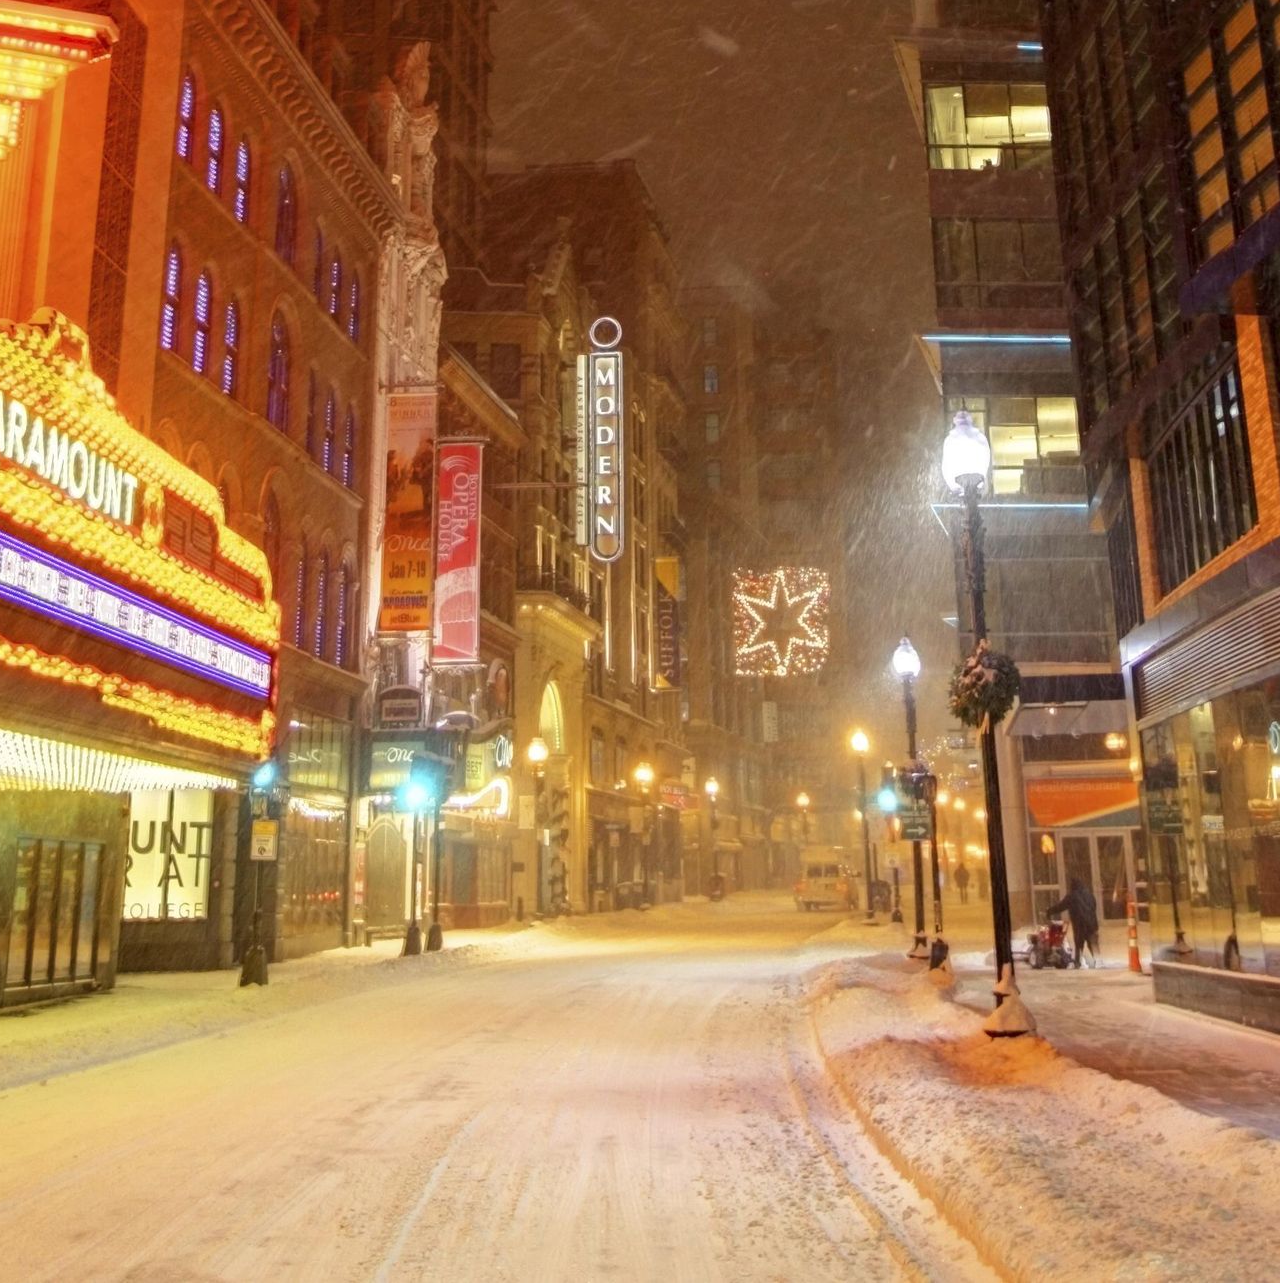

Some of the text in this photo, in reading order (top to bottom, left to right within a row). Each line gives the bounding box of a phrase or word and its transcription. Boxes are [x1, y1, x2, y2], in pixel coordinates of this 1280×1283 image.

[595, 368, 616, 535] MODERN
[438, 500, 452, 562] HOUSE
[451, 471, 469, 547] OPERA
[469, 473, 479, 521] BOSTON
[388, 560, 406, 579] Jan
[661, 593, 675, 678] SUFFOLK
